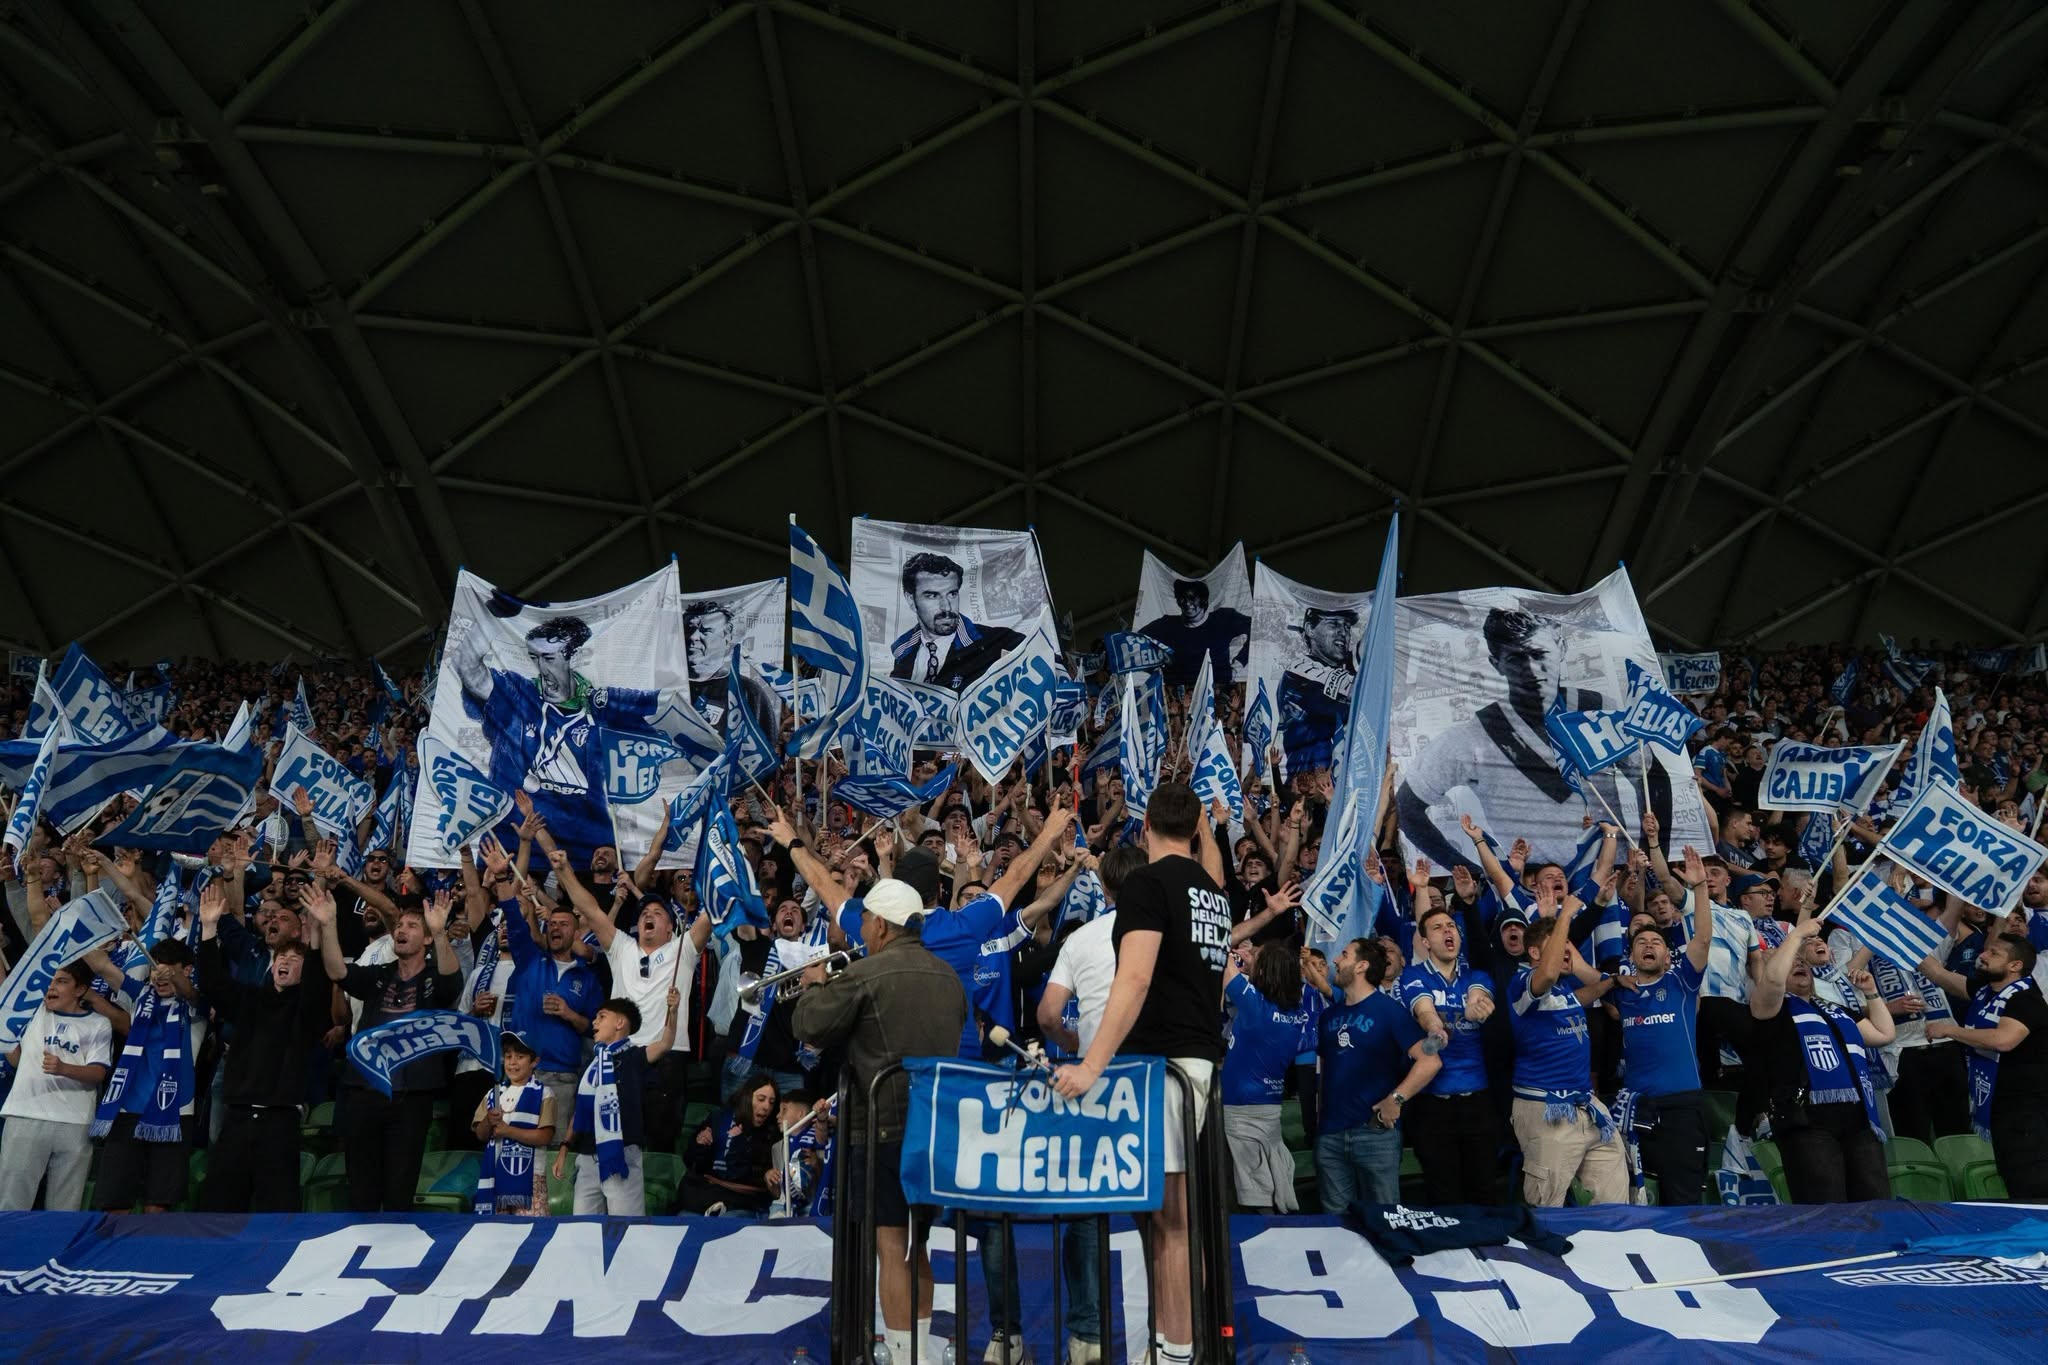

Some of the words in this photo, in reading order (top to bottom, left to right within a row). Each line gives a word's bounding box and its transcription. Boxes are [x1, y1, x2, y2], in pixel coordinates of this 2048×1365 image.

[1668, 665, 1716, 689] HELLAS
[1675, 659, 1716, 672] FORZA
[867, 686, 917, 736] FORZA
[276, 756, 352, 830] HELLA
[1890, 806, 2006, 909] HELLAS
[1940, 806, 2028, 881] FORZA
[954, 1097, 1142, 1192] HELLAS
